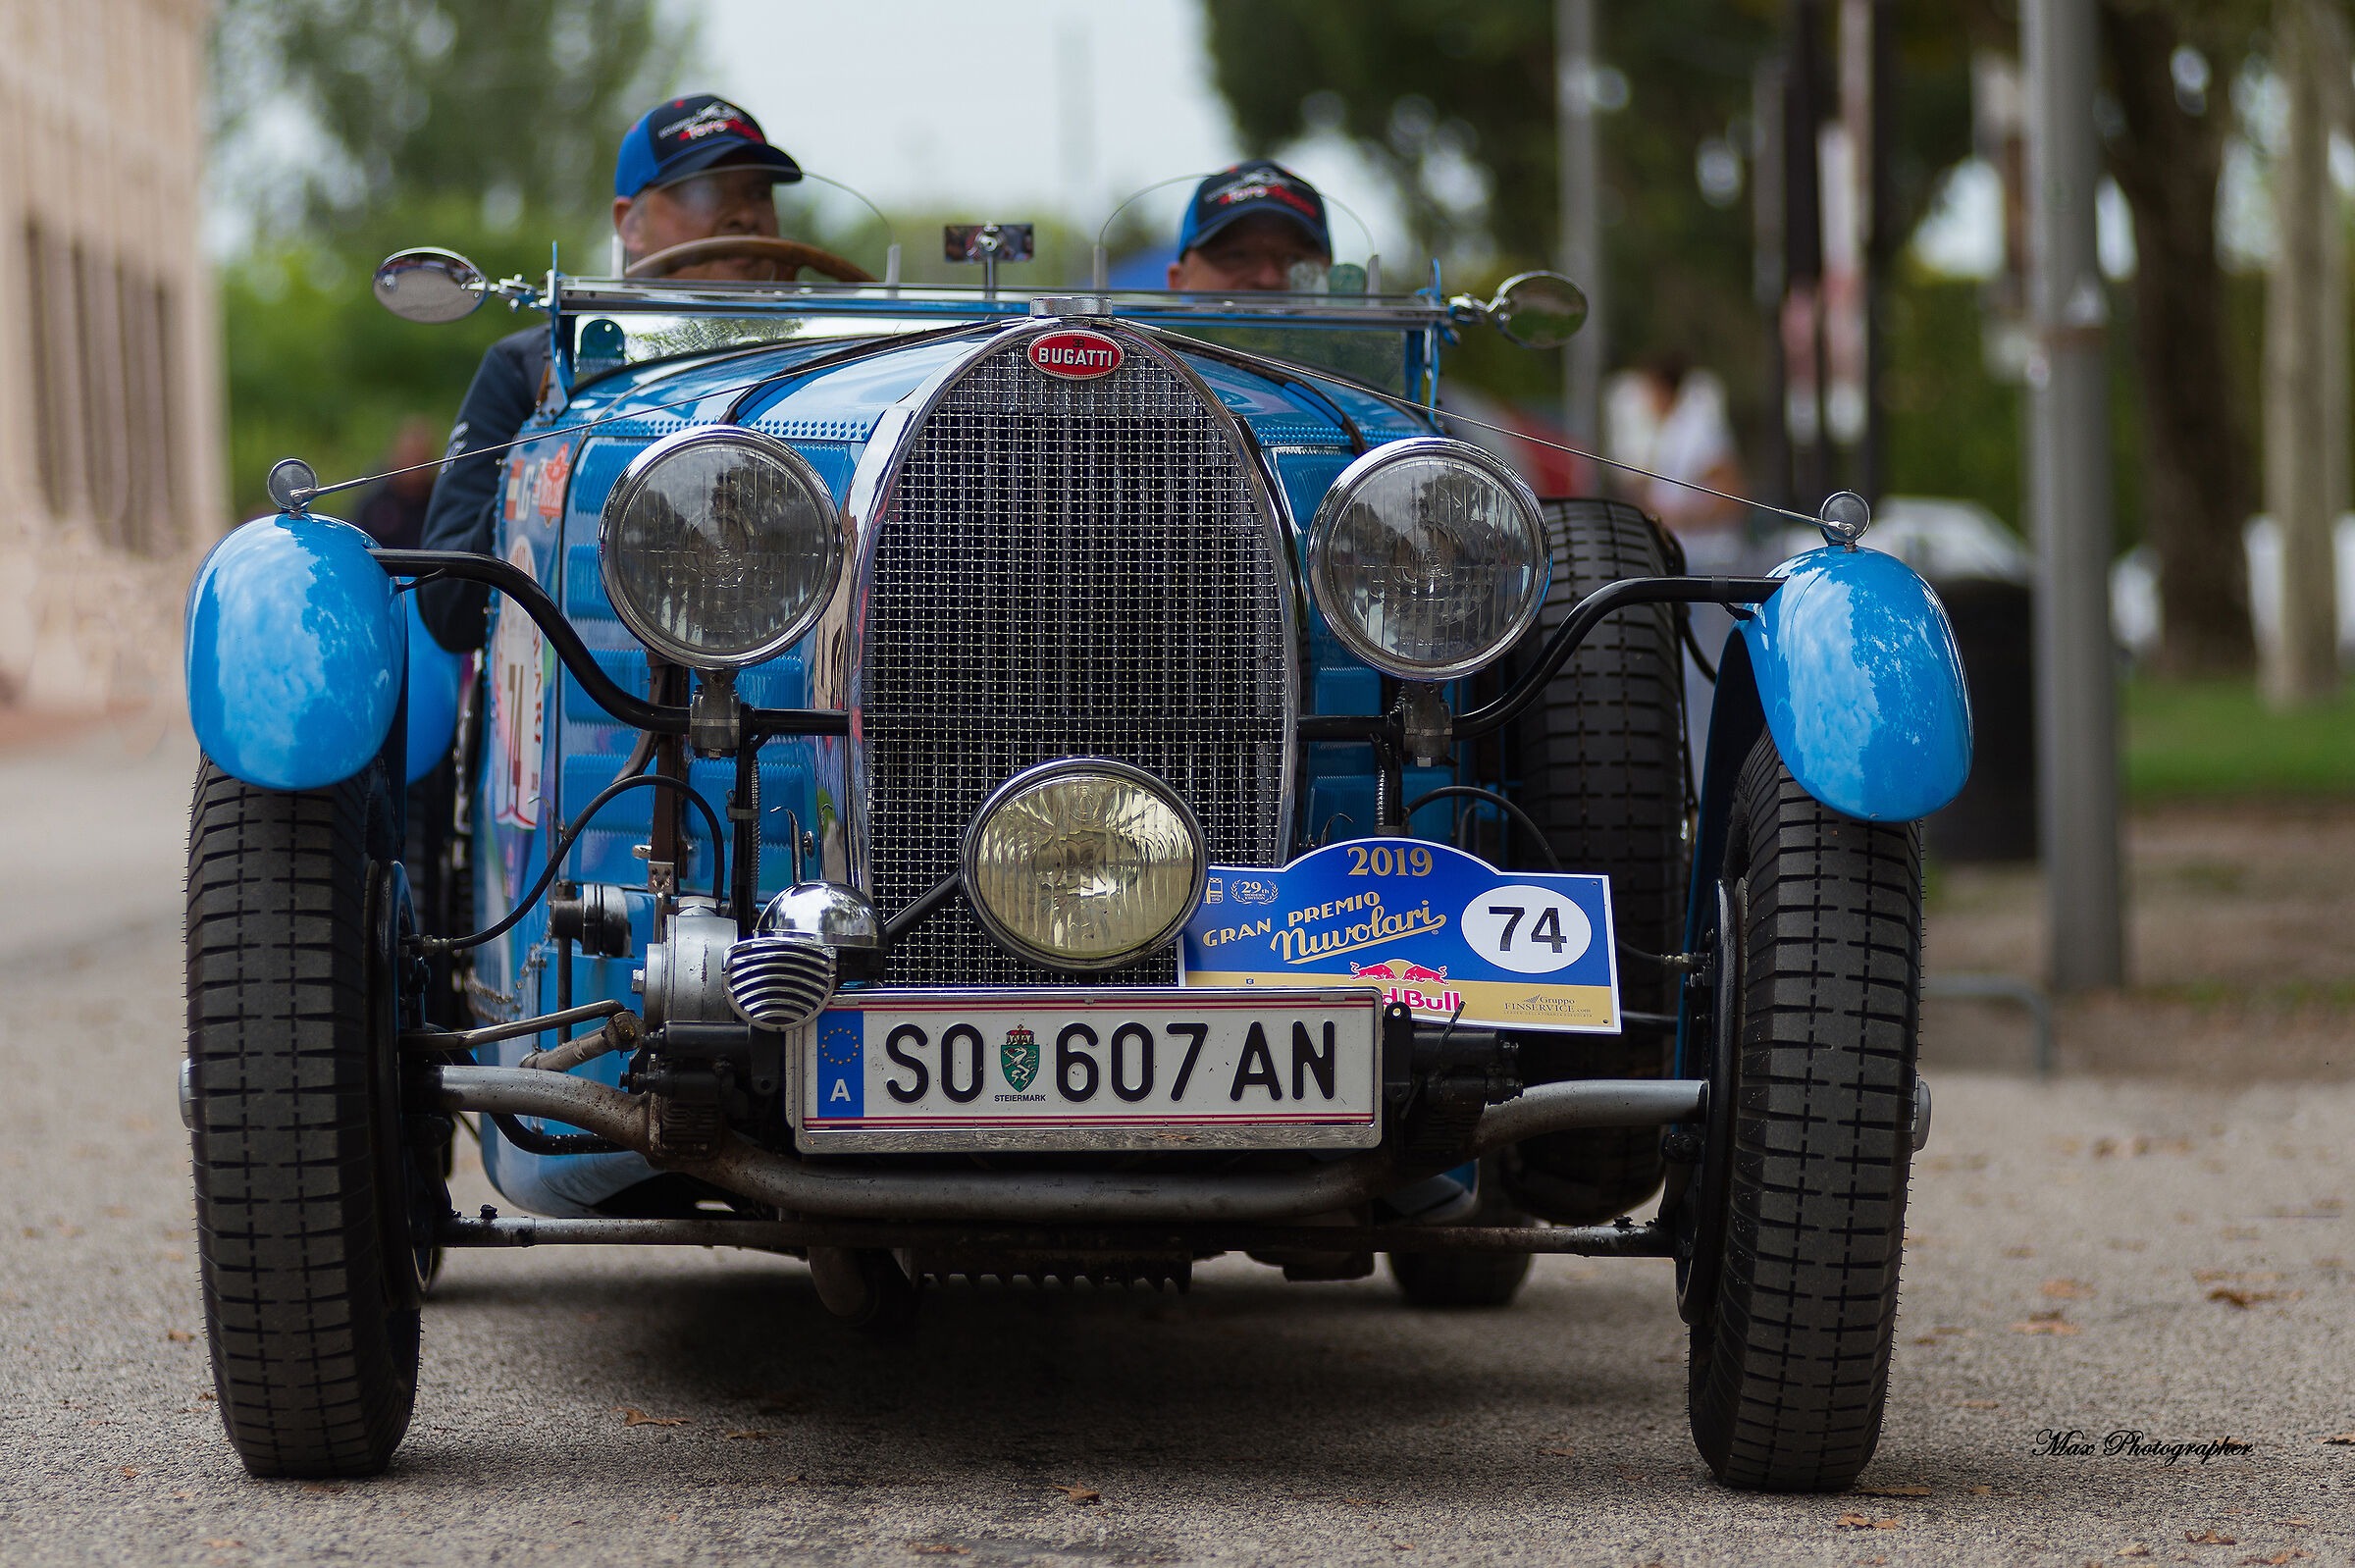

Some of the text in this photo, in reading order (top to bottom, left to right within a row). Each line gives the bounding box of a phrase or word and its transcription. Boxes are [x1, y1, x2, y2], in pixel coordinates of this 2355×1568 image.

[1038, 347, 1113, 367] BUGATTI
[1347, 846, 1434, 877] 2019
[1240, 881, 1270, 894] 29th
[1202, 891, 1381, 947] GRAN PREMIO
[1270, 900, 1447, 964] Nuvolari
[1488, 905, 1567, 954] 74
[1403, 989, 1460, 1012] Bull
[1540, 996, 1575, 1006] Gruppo
[885, 1021, 1335, 1103] SO 607 AN
[830, 1078, 852, 1102] A
